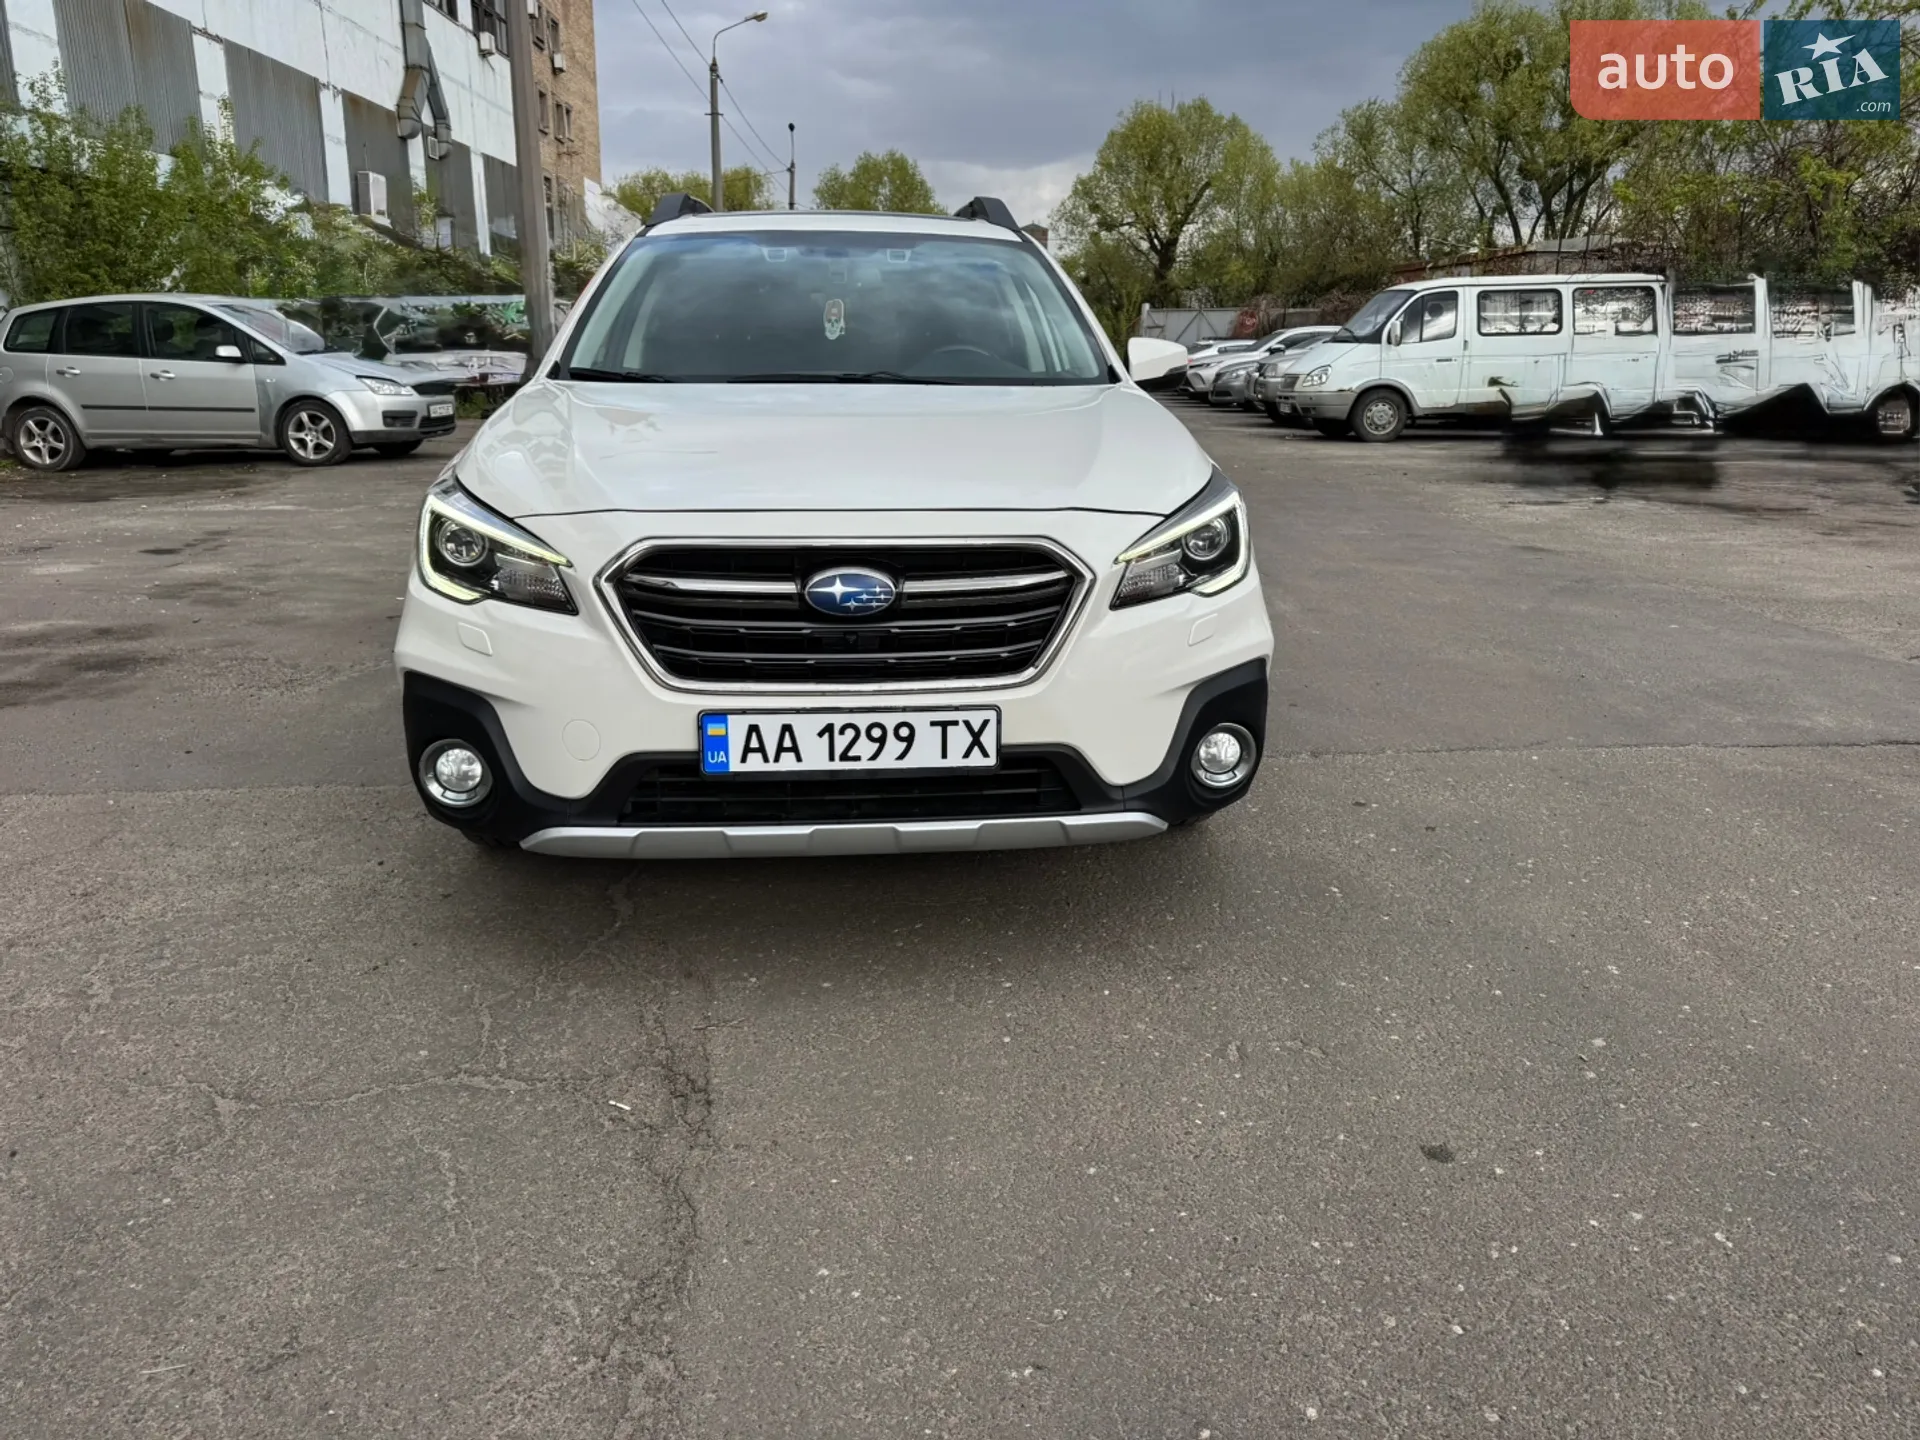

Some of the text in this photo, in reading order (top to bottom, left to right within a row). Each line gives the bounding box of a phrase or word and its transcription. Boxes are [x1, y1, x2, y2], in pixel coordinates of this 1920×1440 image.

[740, 718, 991, 763] AA 1299 TX
[707, 750, 727, 763] UA
